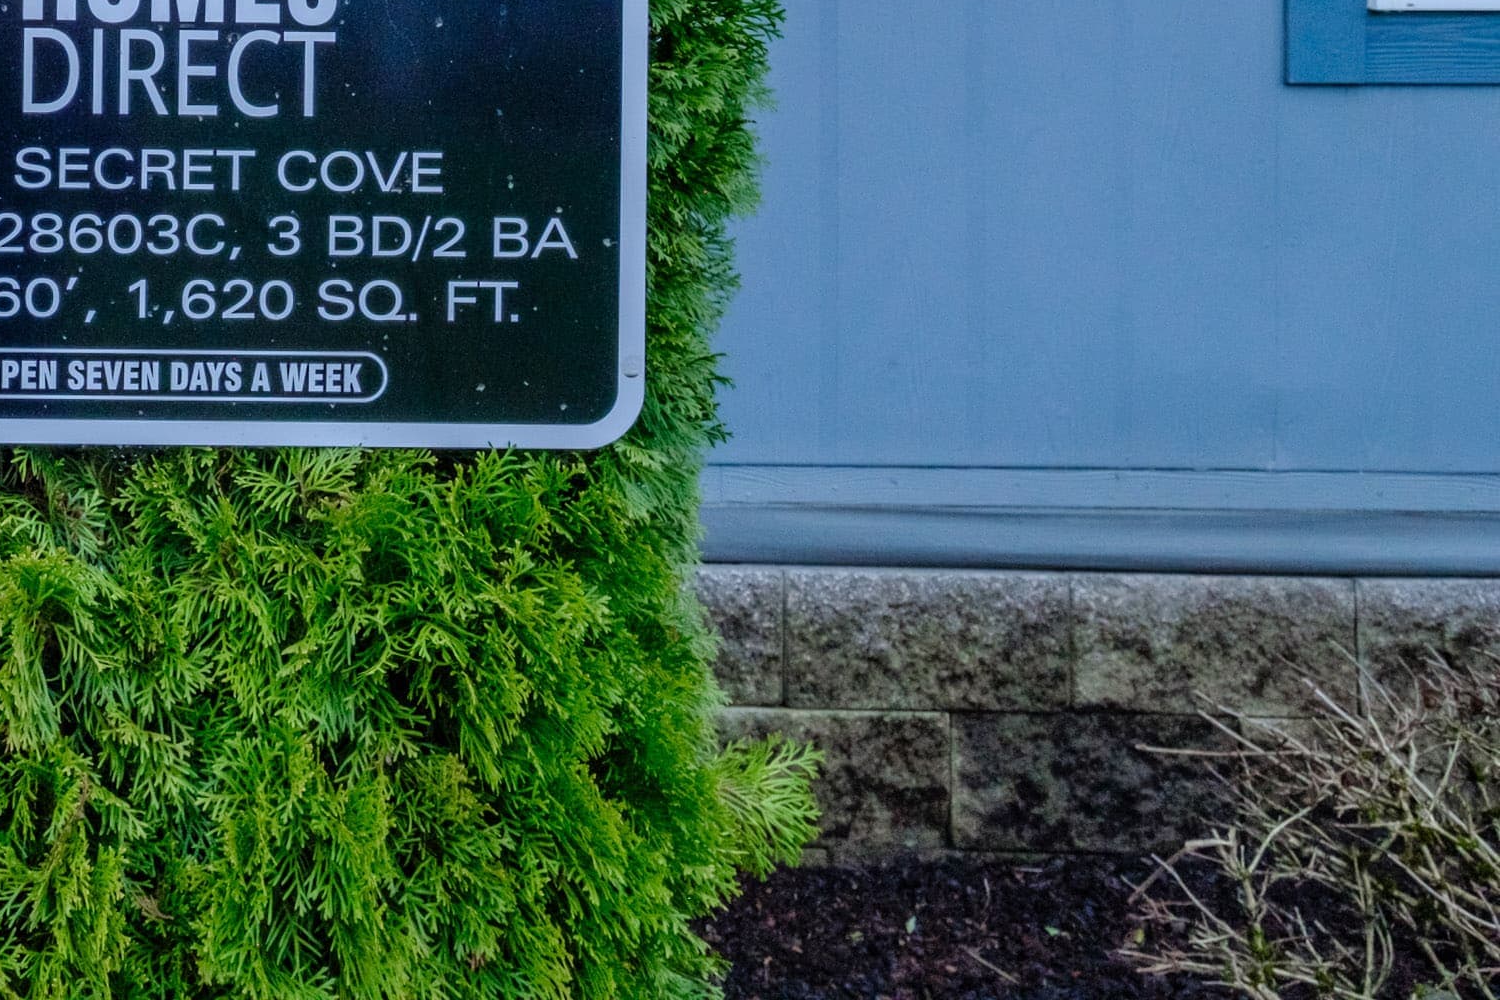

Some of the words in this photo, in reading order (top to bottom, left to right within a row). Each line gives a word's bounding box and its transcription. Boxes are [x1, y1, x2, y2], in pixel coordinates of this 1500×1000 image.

[23, 28, 335, 117] DIRECT
[15, 148, 255, 190] SECRET
[278, 151, 442, 192] COVE
[268, 216, 300, 255] 3
[329, 216, 465, 261] BD/2
[494, 218, 578, 258] BA
[129, 280, 293, 323] 1,620
[318, 280, 416, 320] SQ.
[448, 282, 518, 321] FT.
[68, 361, 159, 390] SEVEN
[171, 362, 241, 391] DAYS
[251, 363, 270, 391] A
[280, 363, 361, 392] WEEK
